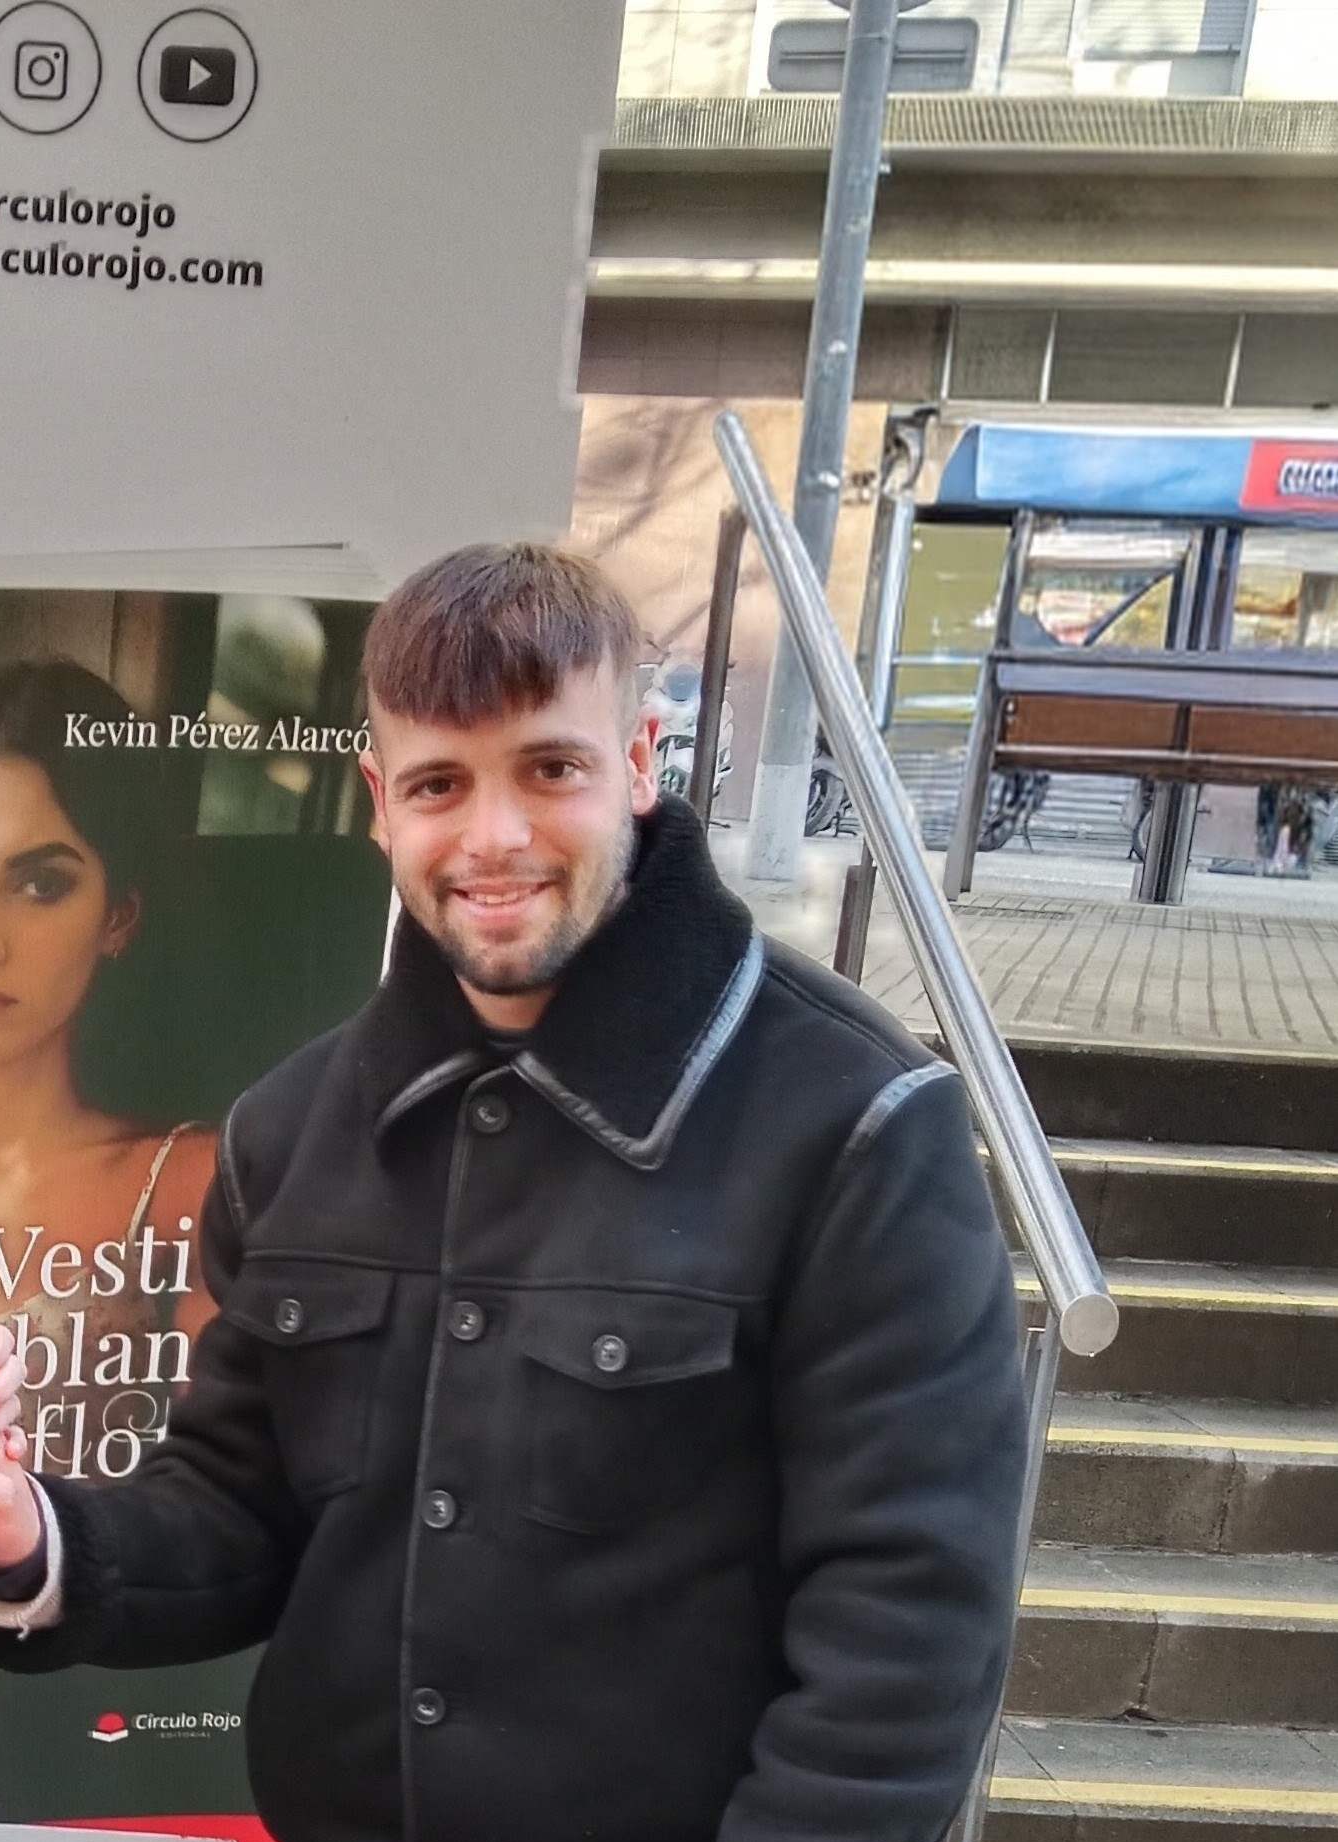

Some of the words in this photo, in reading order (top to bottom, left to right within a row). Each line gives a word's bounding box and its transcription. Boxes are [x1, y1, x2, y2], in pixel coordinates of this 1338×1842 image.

[64, 711, 158, 748] Kevin
[168, 711, 260, 752] Pérez
[10, 1310, 193, 1391] blan
[135, 1712, 197, 1729] Círculo
[202, 1712, 241, 1731] Rojo
